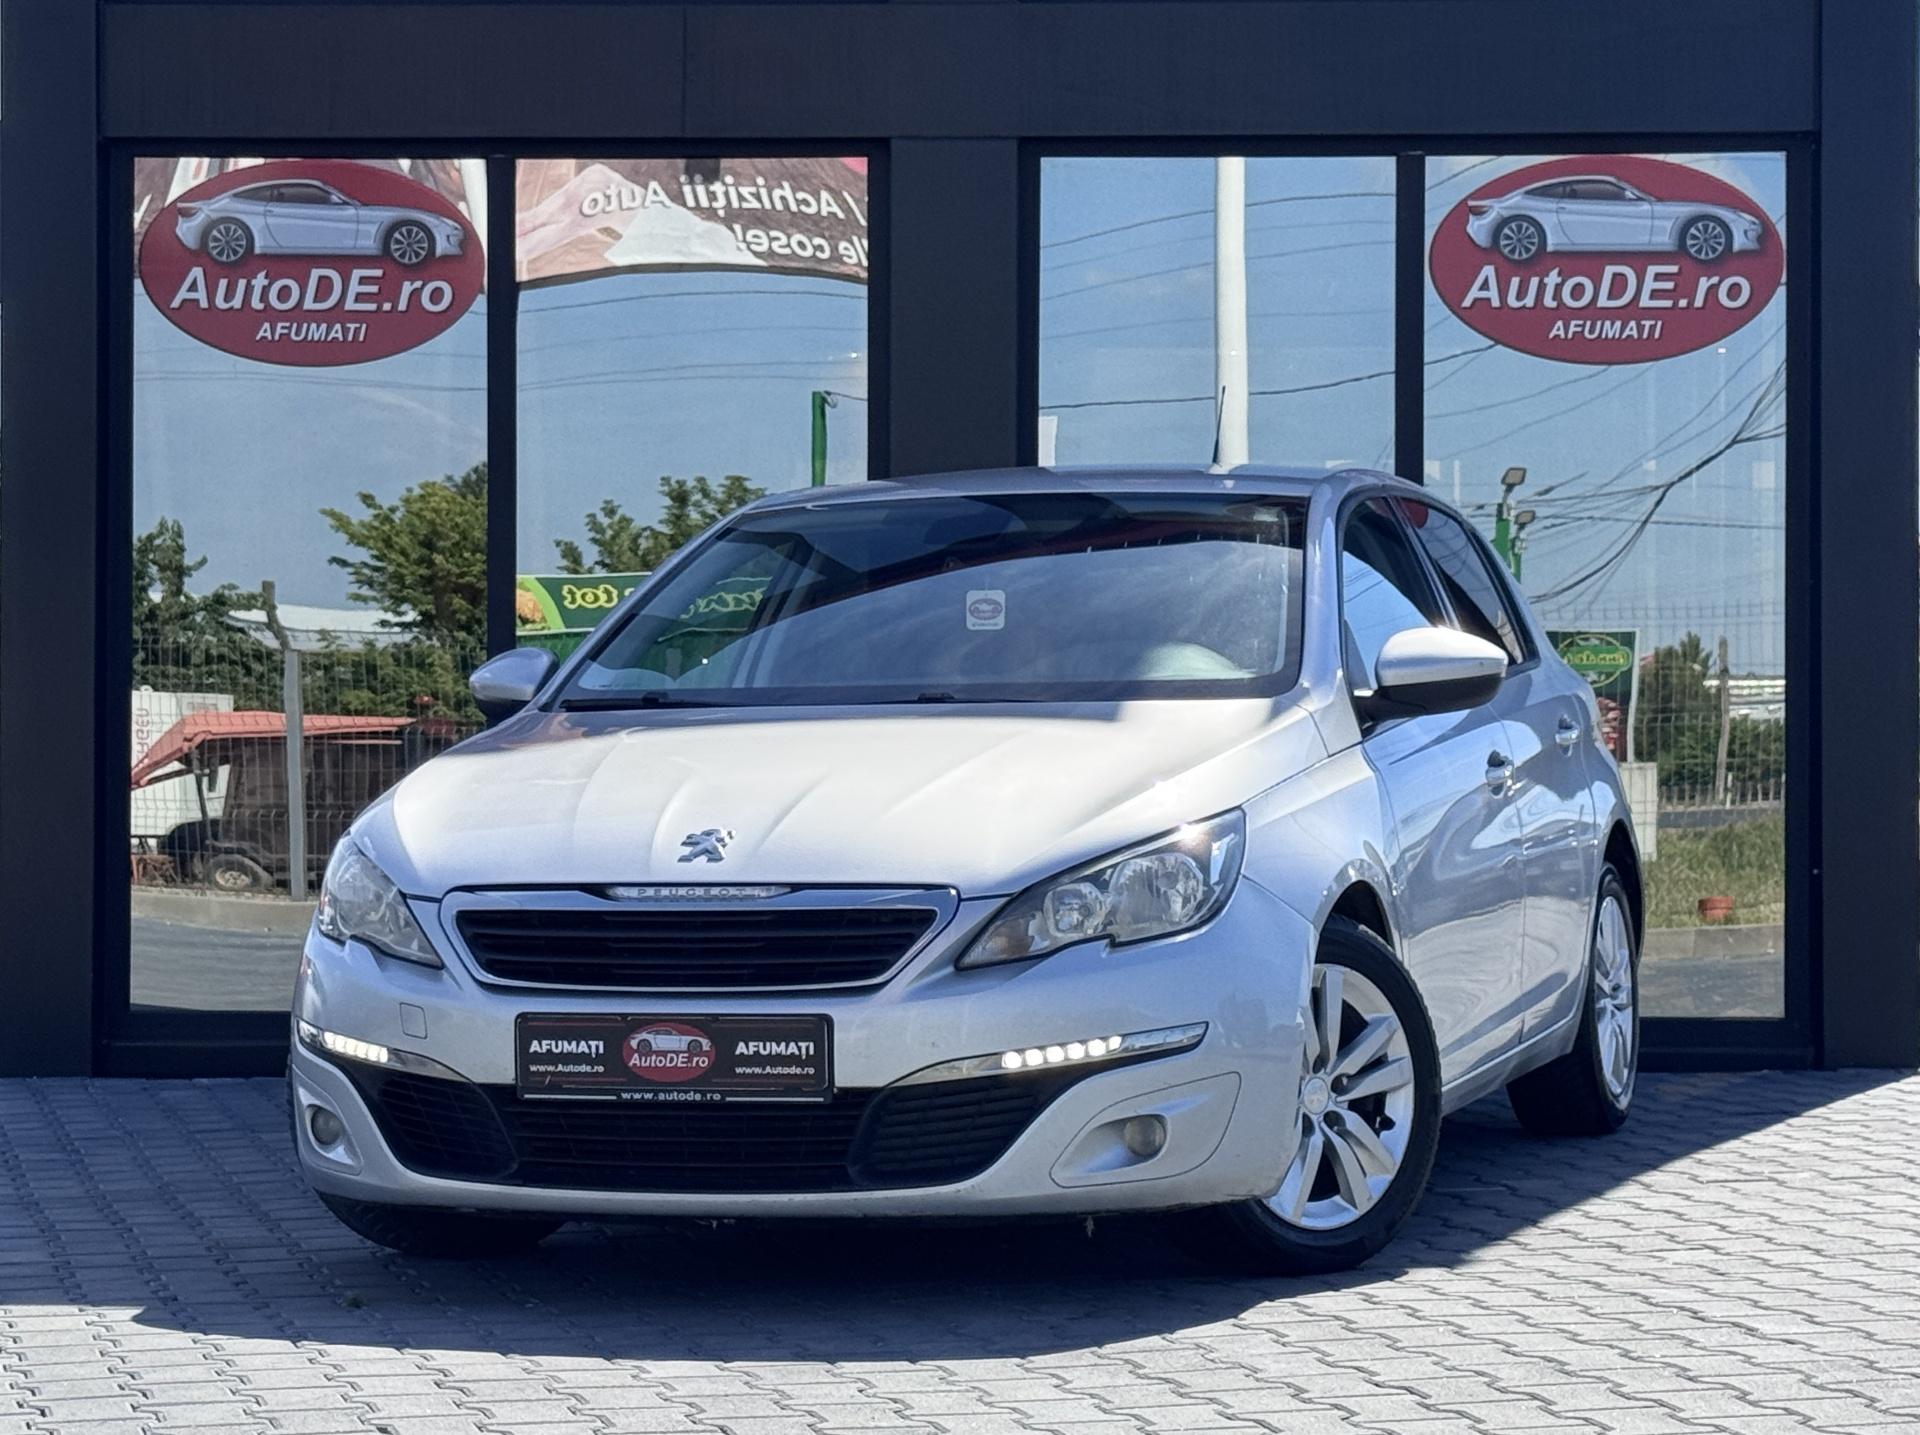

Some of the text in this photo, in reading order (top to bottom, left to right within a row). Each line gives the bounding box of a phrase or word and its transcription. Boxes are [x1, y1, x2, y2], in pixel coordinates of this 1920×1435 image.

[170, 266, 455, 313] AutoDE.ro
[1461, 264, 1753, 310] AutoDE.ro
[255, 321, 368, 342] AFUMATI
[1548, 319, 1663, 340] AFUMATI
[636, 887, 746, 898] PEUGEOT
[528, 1063, 606, 1074] www.Autode.ro
[628, 1052, 710, 1069] AutoDE.ro
[735, 1065, 816, 1076] www.Autode.ro
[620, 1090, 722, 1102] www.autode.ro
